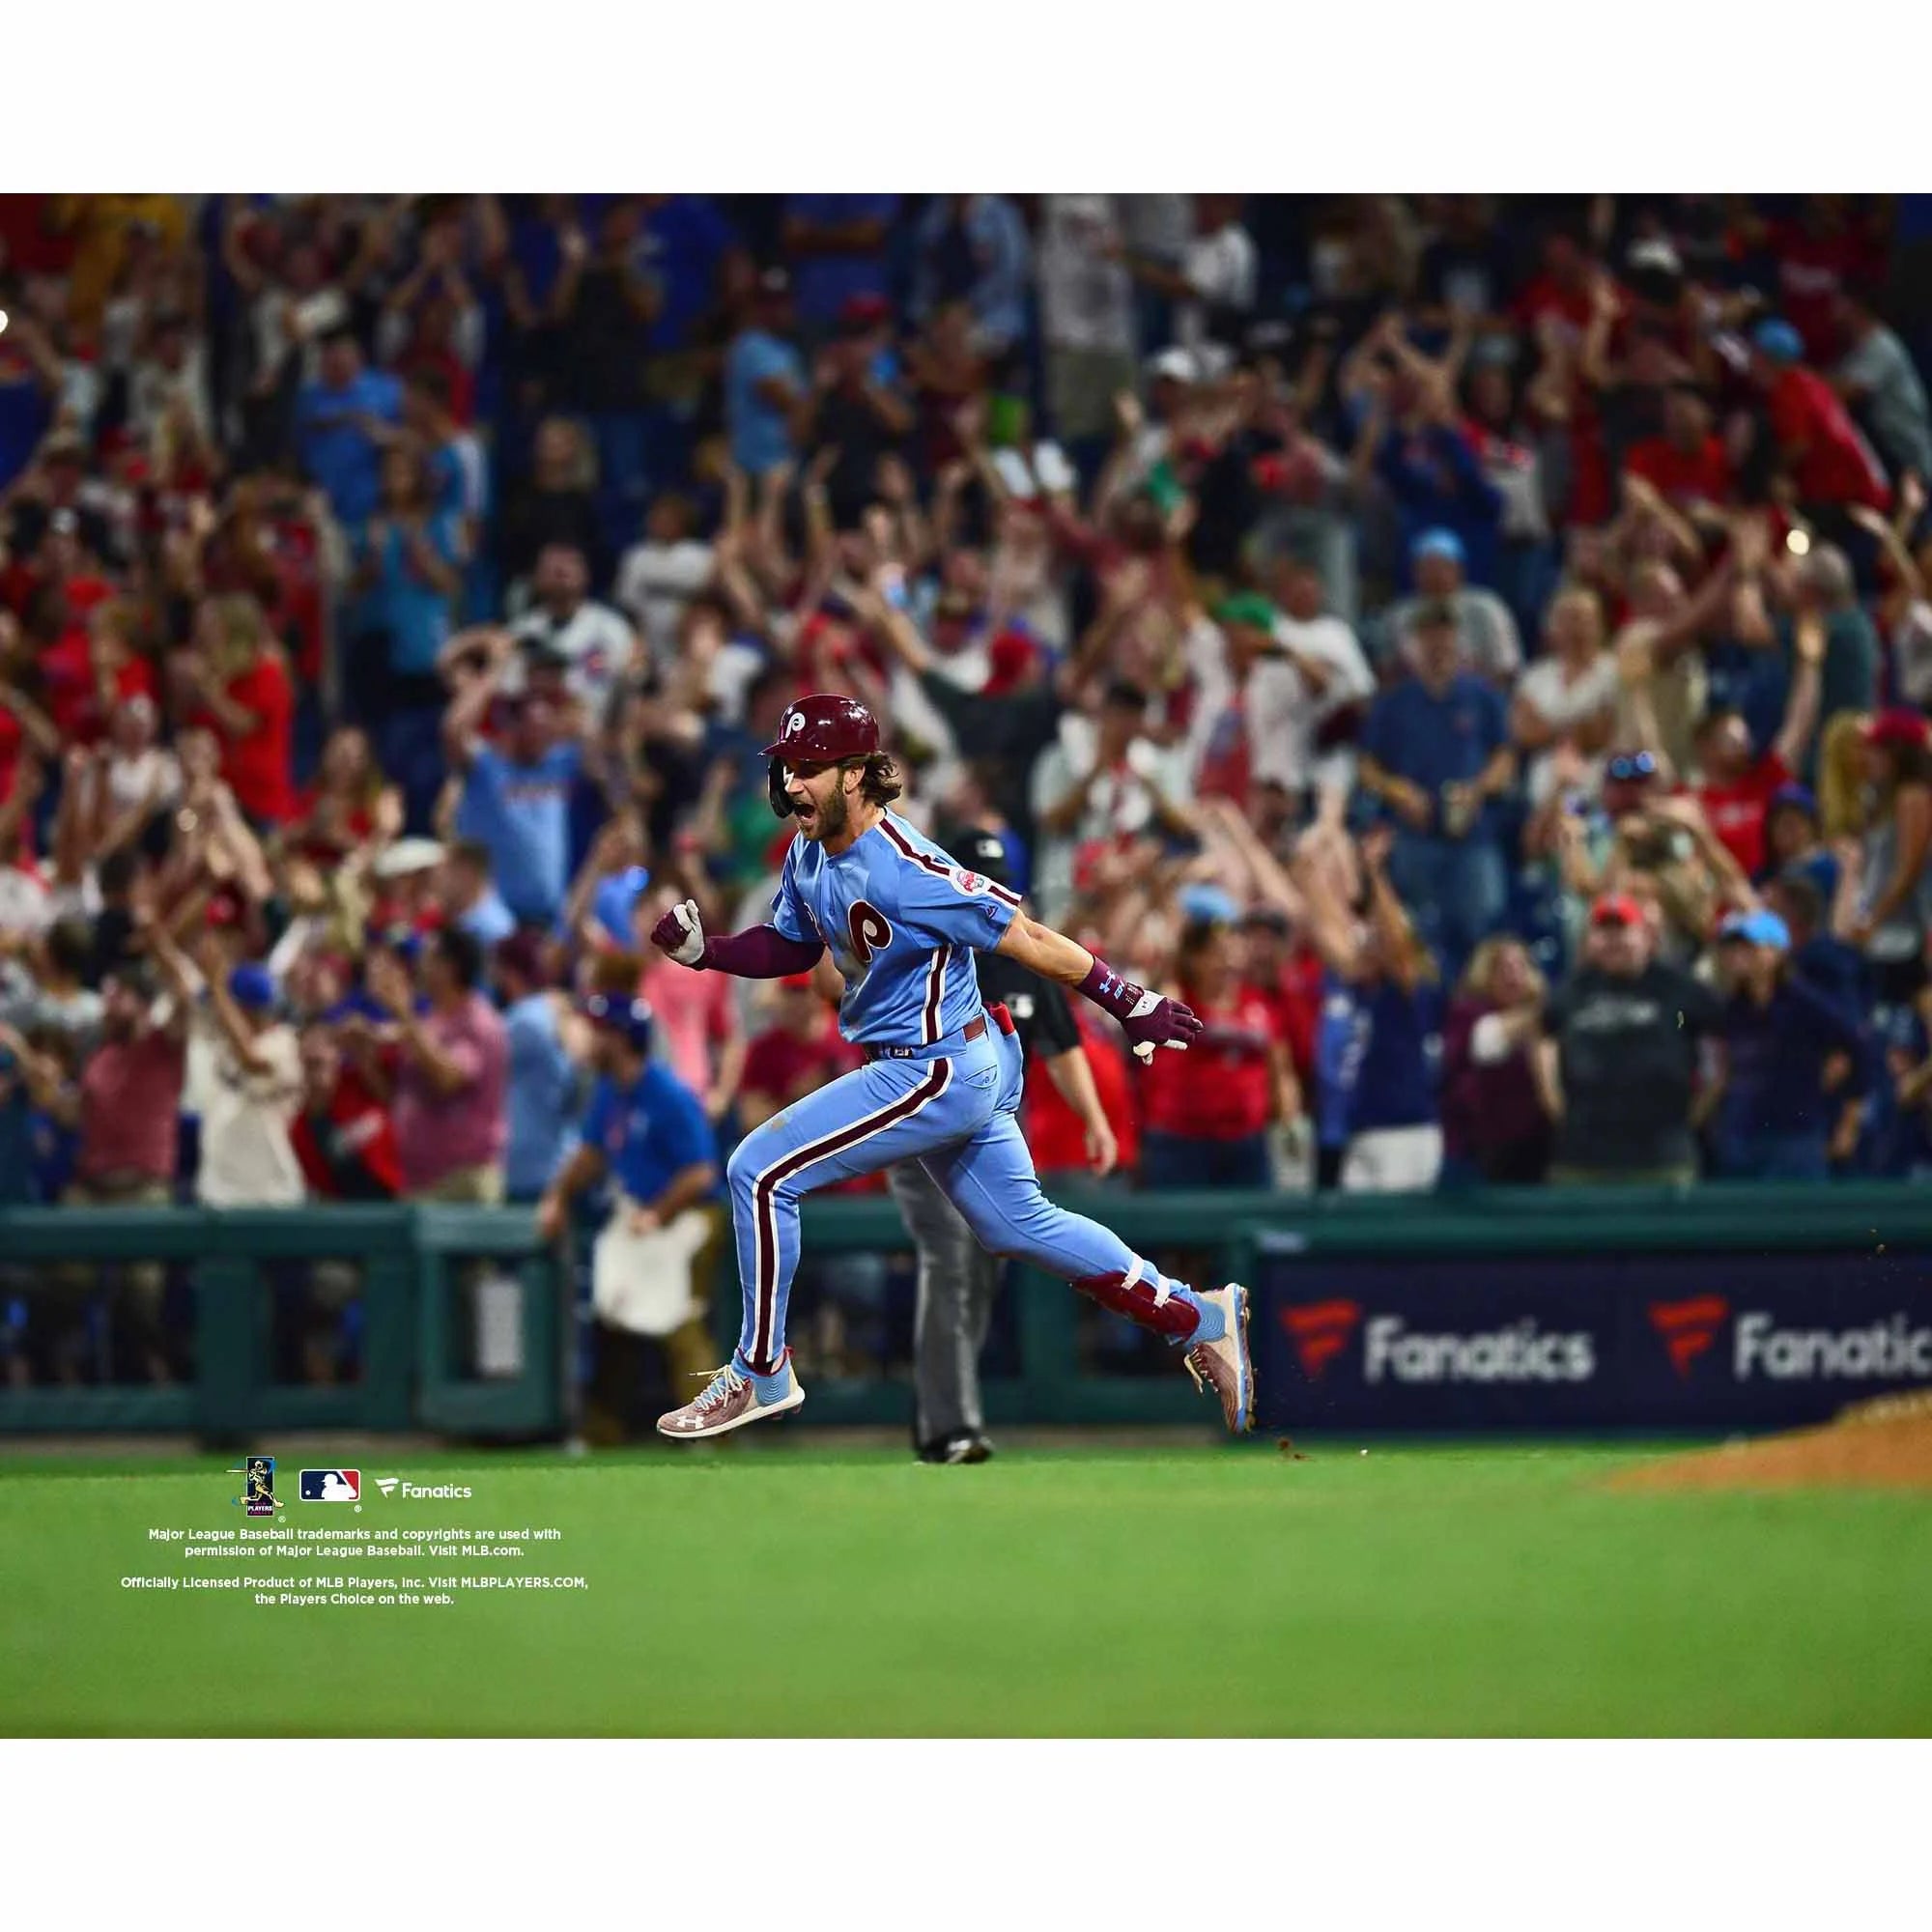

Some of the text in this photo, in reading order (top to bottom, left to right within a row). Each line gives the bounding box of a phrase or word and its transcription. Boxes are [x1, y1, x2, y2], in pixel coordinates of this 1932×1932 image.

[784, 712, 807, 739] P
[848, 899, 894, 964] P
[1363, 1315, 1596, 1384] Fanatics
